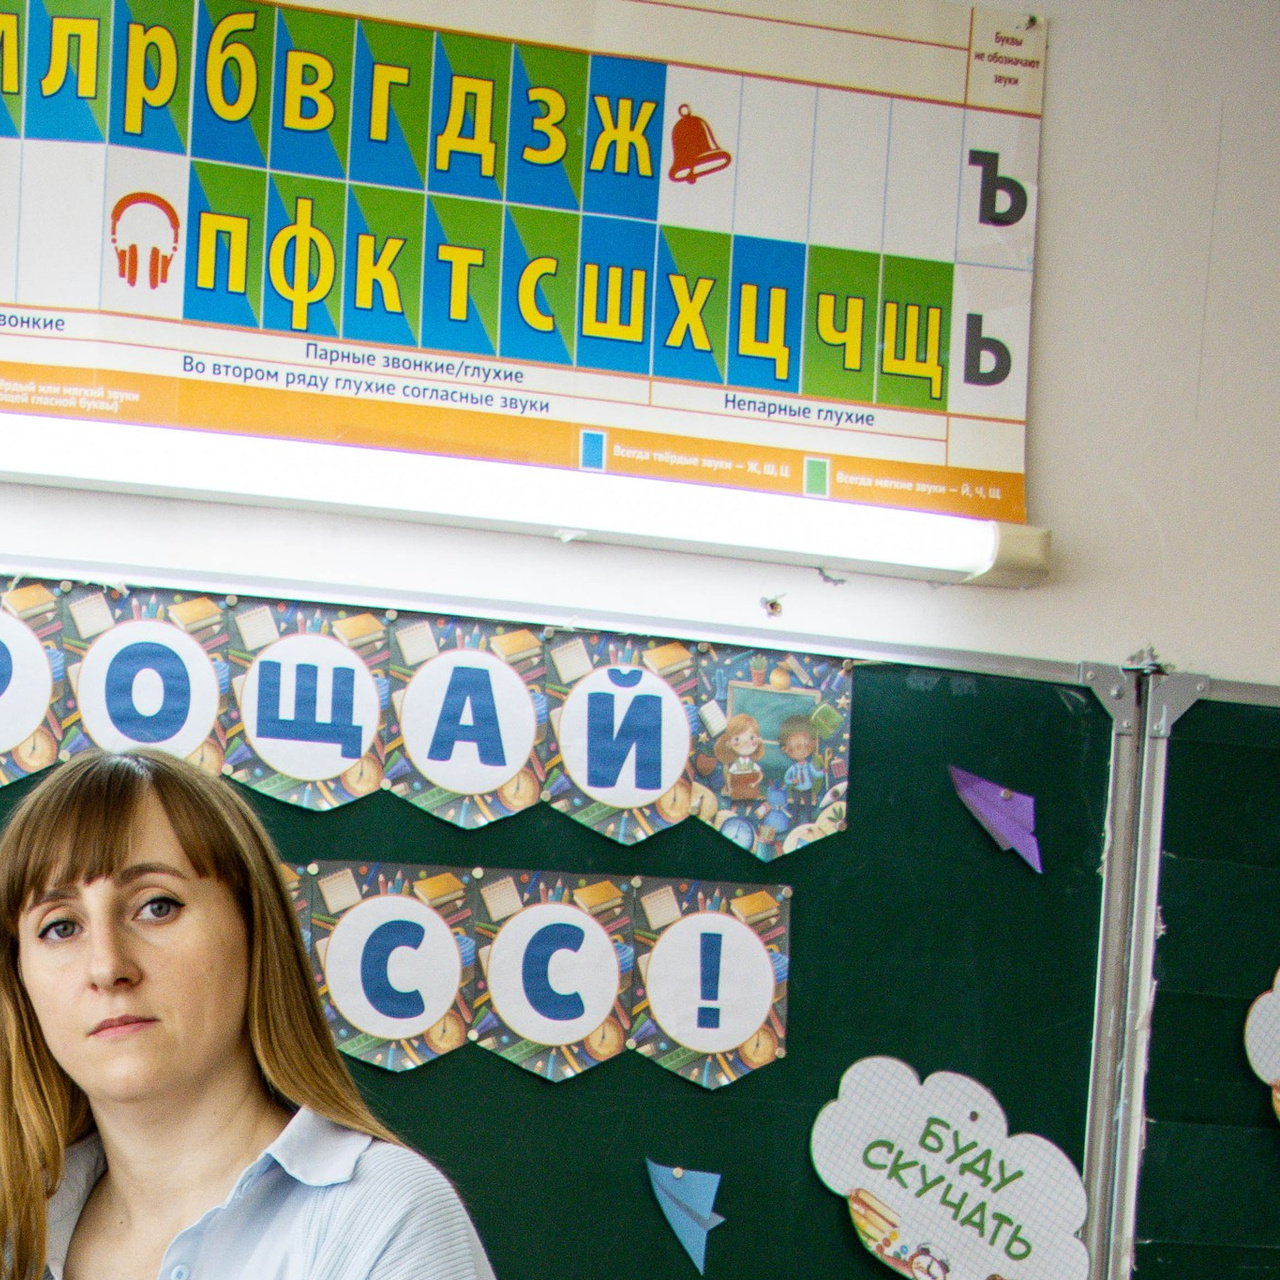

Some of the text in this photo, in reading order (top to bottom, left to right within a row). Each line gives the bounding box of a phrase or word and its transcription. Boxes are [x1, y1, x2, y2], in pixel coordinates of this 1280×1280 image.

[305, 343, 525, 384] Парные звонкие/глухие
[31, 393, 77, 408] гласной
[182, 355, 550, 414] Во втором ряду глухие согласные звуки
[724, 393, 875, 427] Непарные глухие
[613, 444, 650, 460] Всегда
[836, 471, 873, 487] Всегда
[918, 1116, 1024, 1194] БУДУ
[862, 1139, 1032, 1261] СКУЧАТЬ
